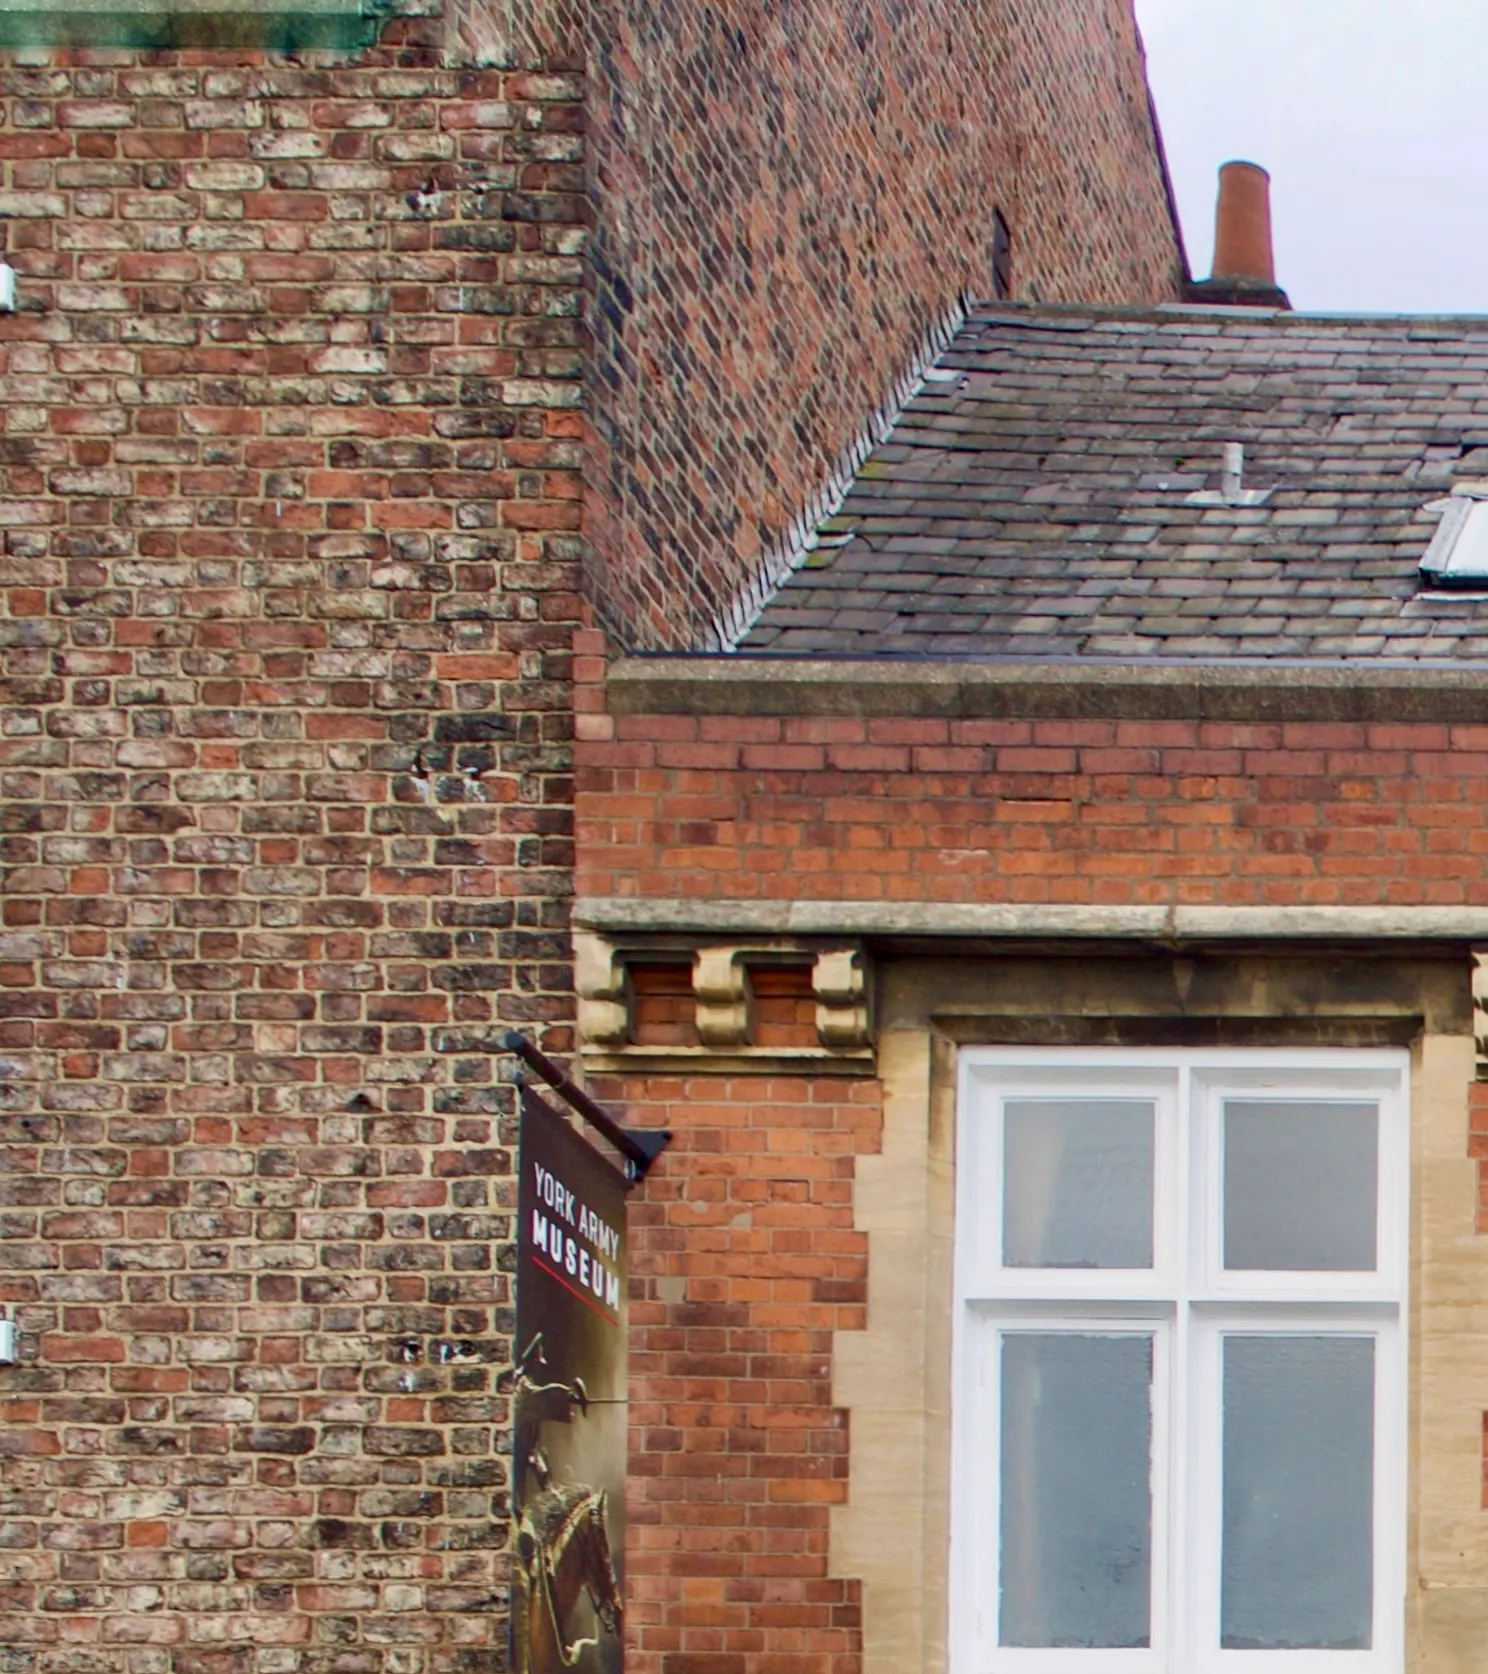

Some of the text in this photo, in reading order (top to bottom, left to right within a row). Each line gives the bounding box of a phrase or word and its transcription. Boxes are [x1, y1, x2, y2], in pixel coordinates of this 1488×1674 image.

[532, 1208, 620, 1312] MUSEUM
[534, 1161, 619, 1263] YORK ARMY
